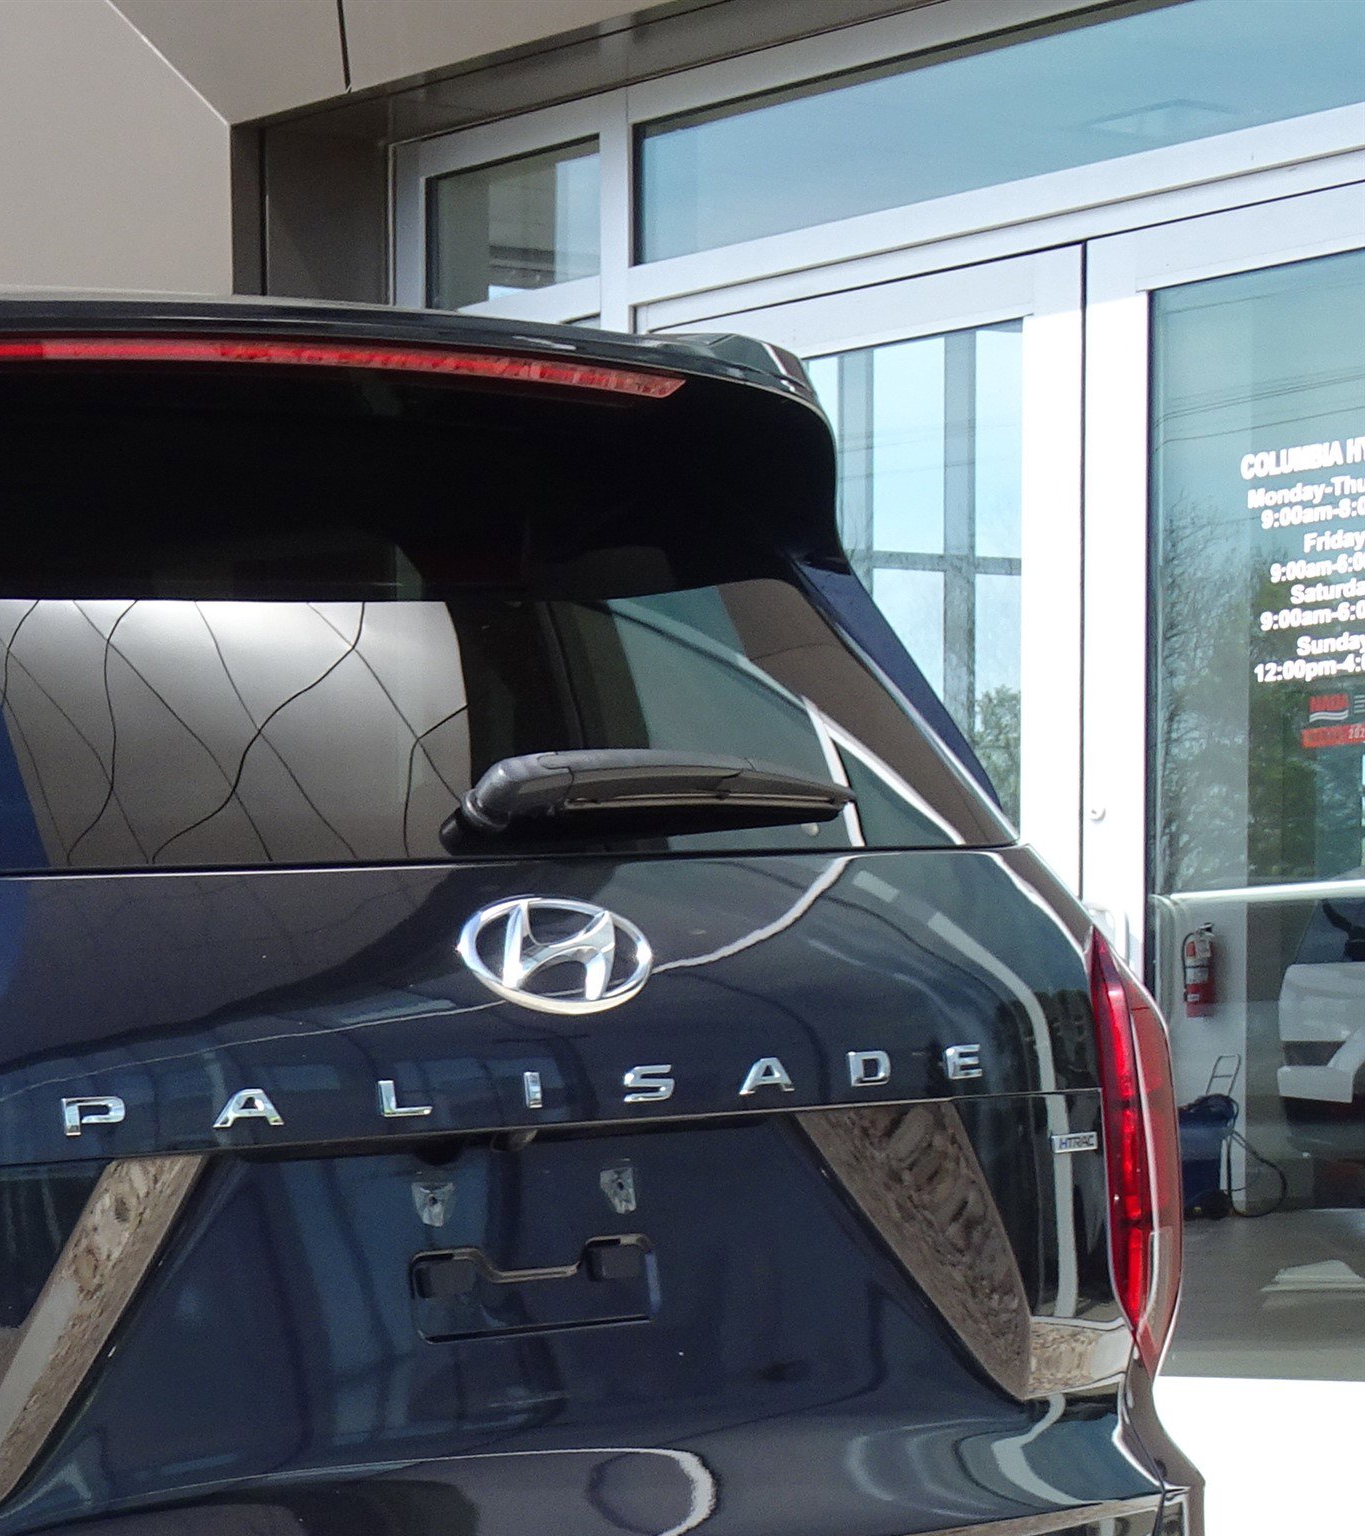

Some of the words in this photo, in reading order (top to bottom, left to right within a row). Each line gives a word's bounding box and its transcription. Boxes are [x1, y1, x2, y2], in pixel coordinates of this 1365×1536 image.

[1303, 529, 1365, 553] Friday
[1270, 551, 1365, 583] 9:00am-6:0
[60, 1041, 985, 1137] PALISADE
